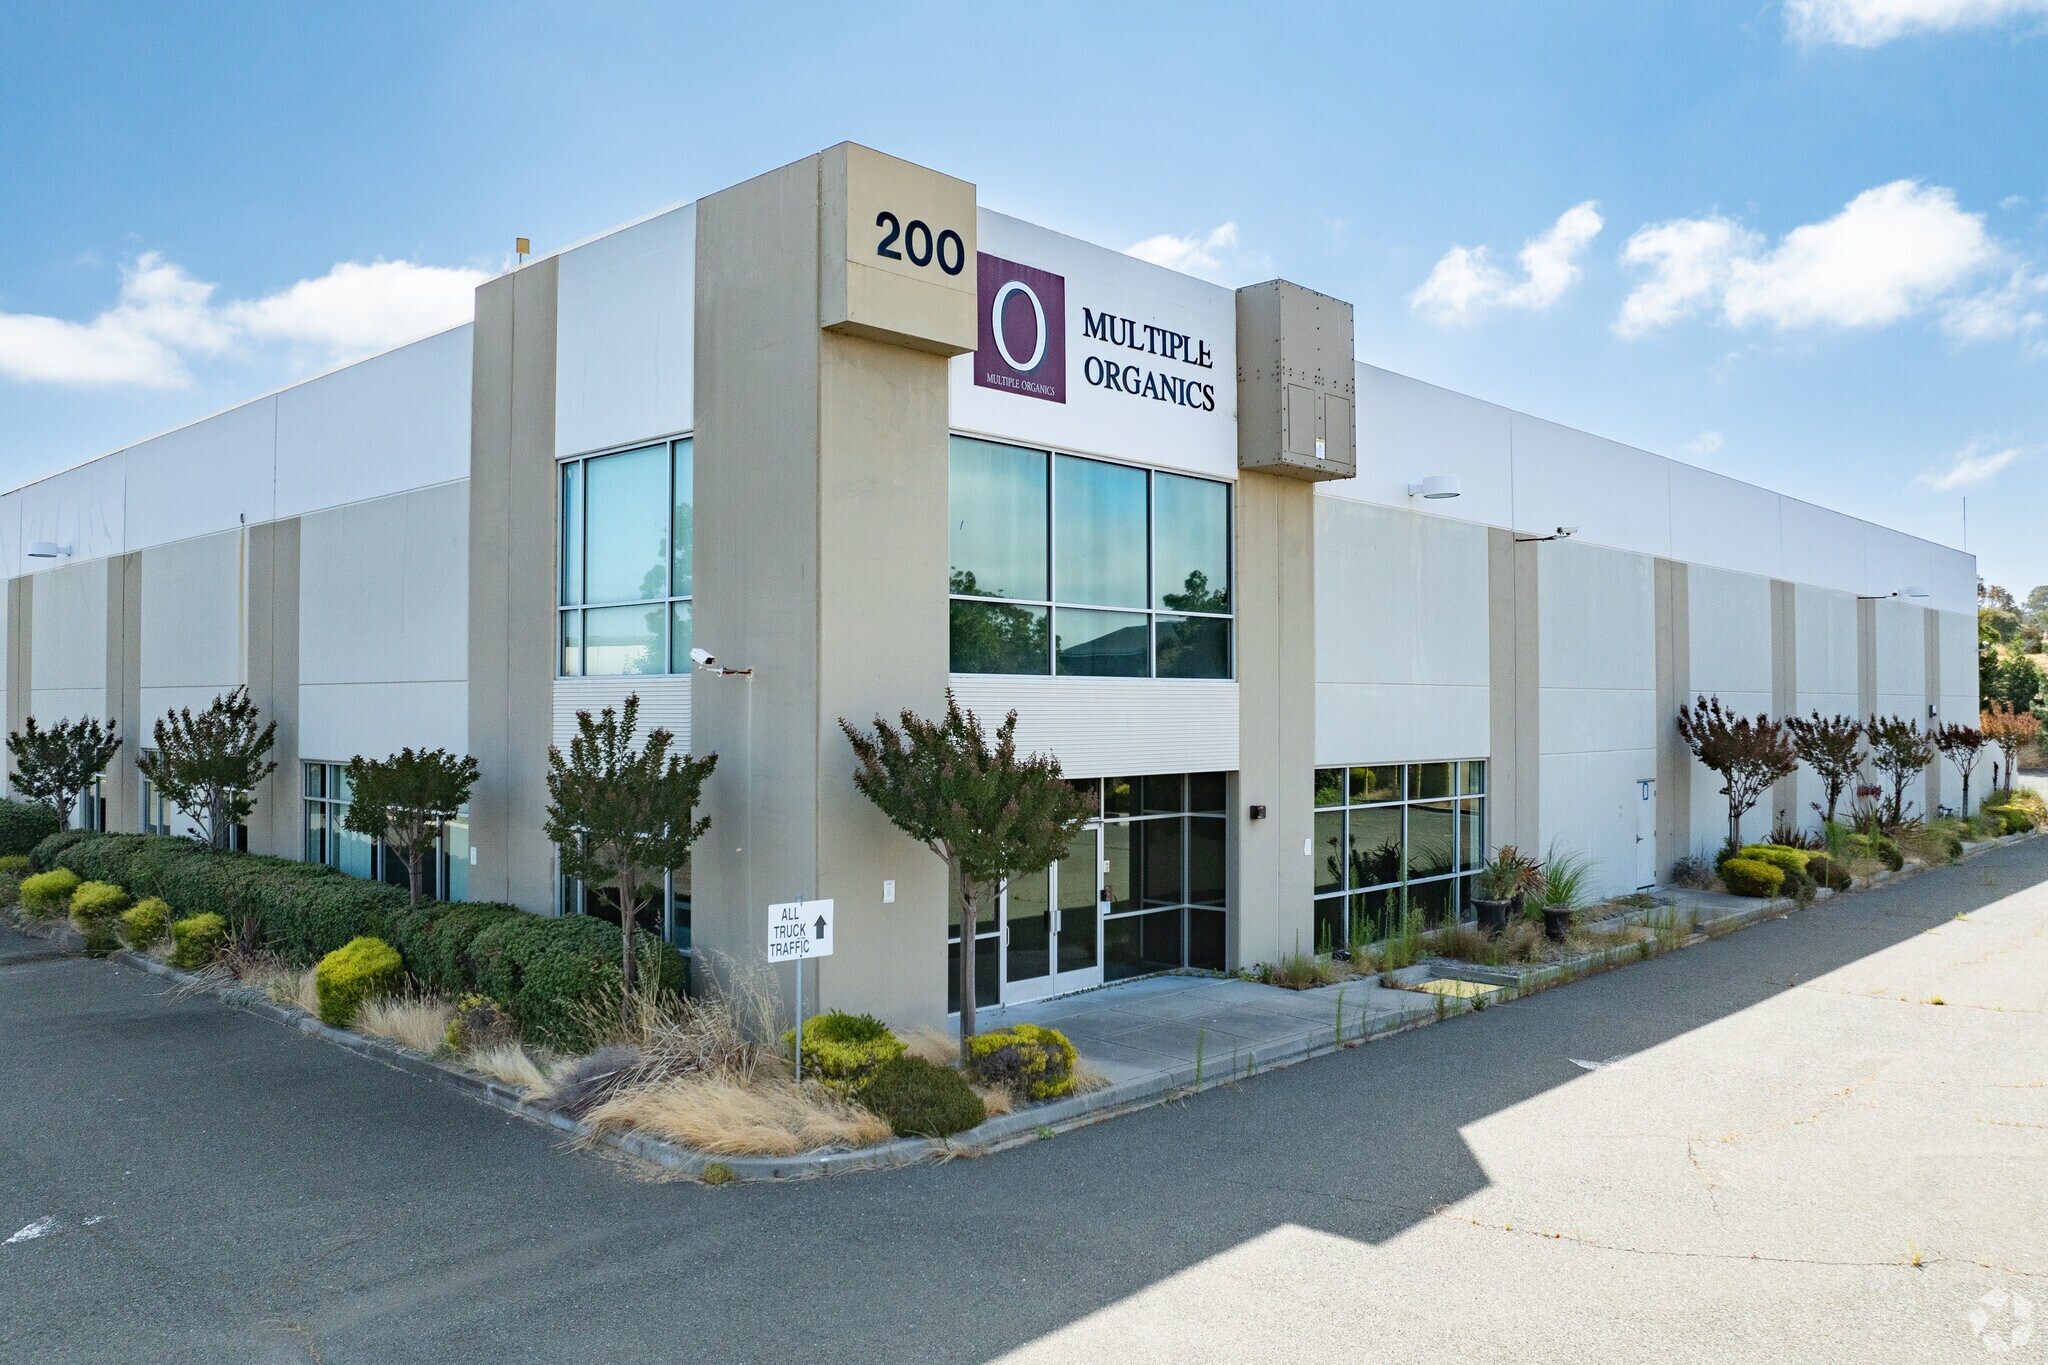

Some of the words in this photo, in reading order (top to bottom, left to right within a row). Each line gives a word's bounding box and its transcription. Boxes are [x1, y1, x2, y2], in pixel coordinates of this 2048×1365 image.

[876, 211, 965, 275] 200
[992, 281, 1046, 371] O
[1082, 307, 1213, 369] MULTIPLE
[986, 373, 1020, 389] MULTIPLE
[1021, 380, 1055, 396] ORGANICS
[1084, 356, 1215, 412] ORGANICS
[774, 923, 806, 939] TRUCK
[781, 907, 799, 921] ALL
[770, 939, 810, 957] TRAFFIC
